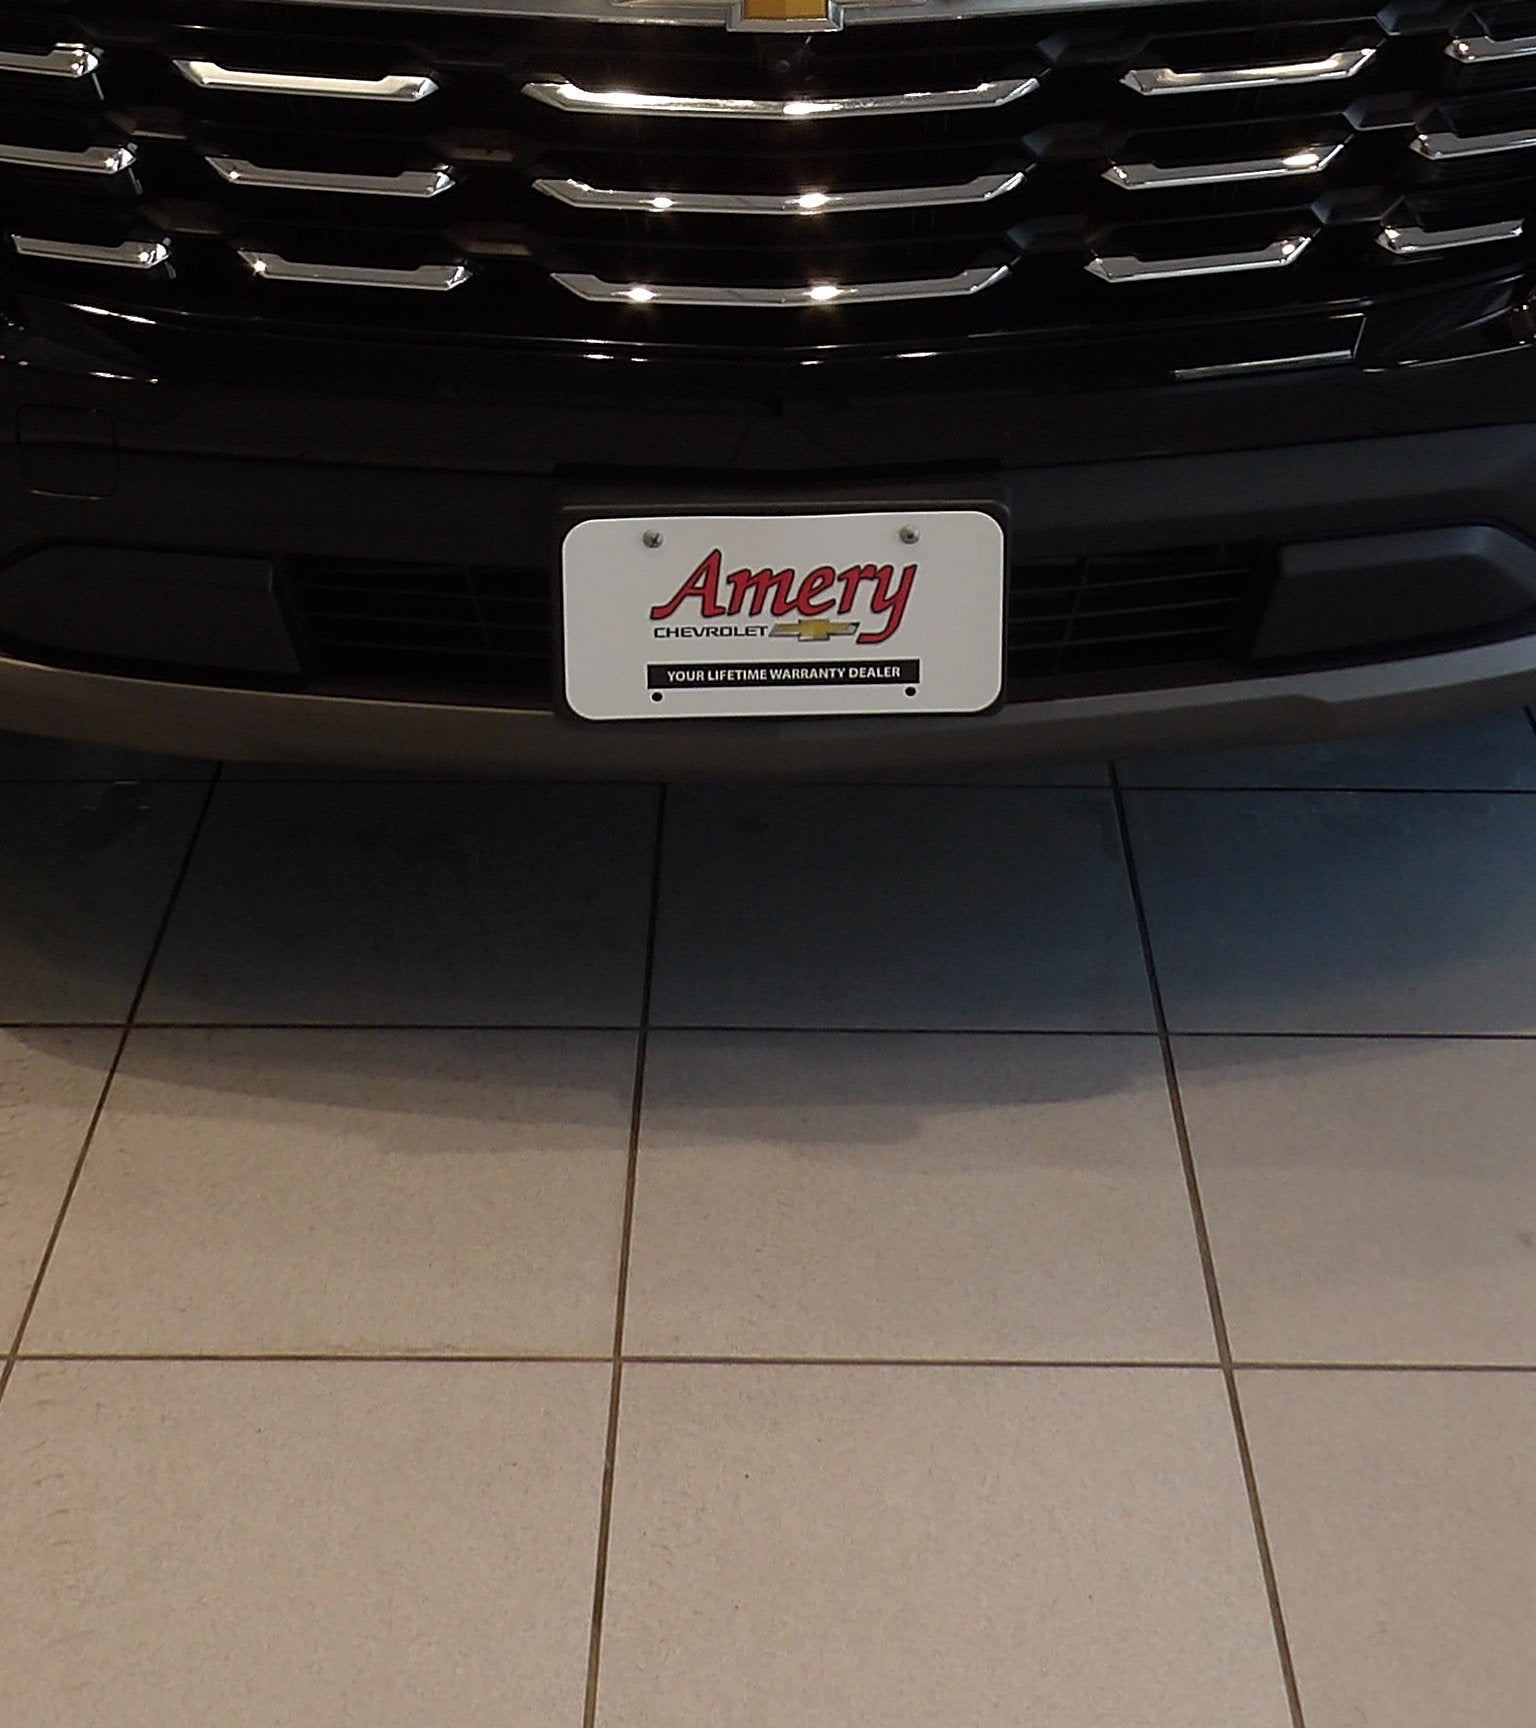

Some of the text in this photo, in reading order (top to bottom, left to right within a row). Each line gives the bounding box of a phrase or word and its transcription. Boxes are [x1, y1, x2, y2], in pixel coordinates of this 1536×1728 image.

[650, 548, 918, 644] Amery
[653, 625, 768, 639] CHEVROLET
[667, 666, 901, 683] YOUR LIFETIME WARRANTY DEALER
